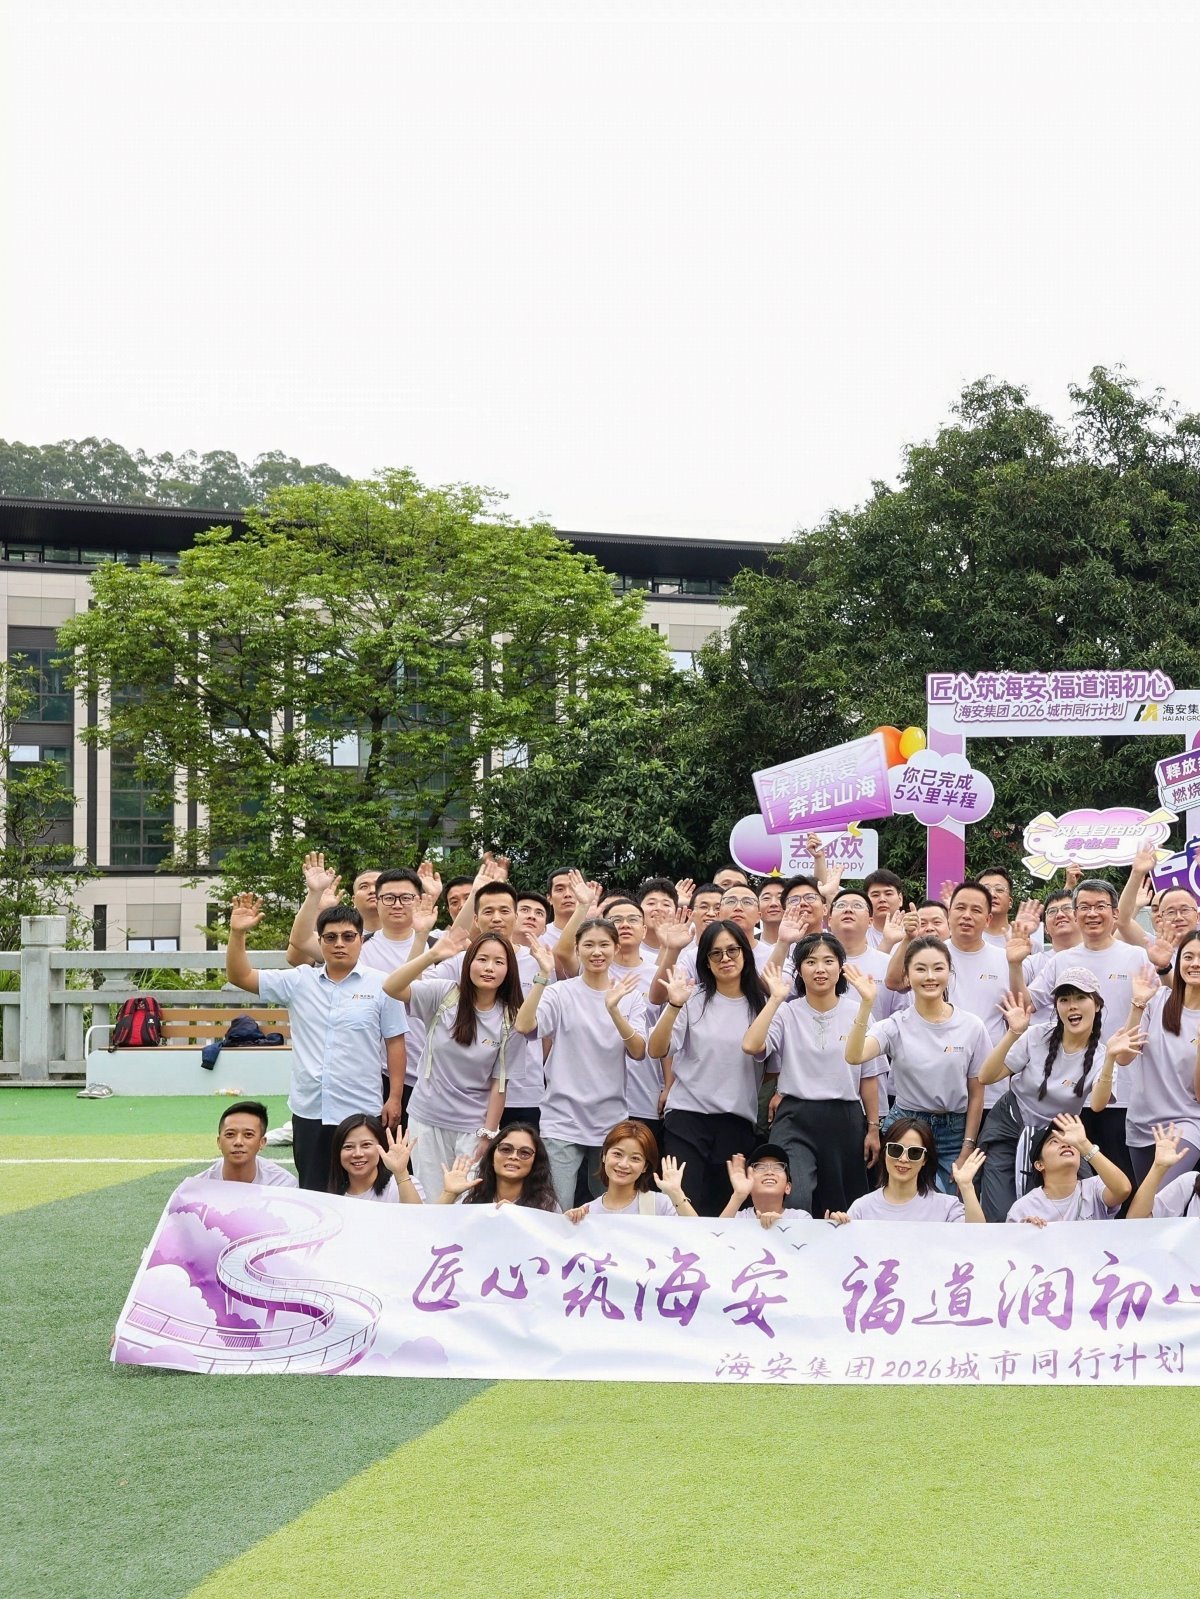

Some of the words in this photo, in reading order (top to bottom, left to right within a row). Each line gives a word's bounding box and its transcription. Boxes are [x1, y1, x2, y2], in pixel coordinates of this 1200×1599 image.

[930, 674, 1047, 701] 匠心筑海安
[1051, 673, 1171, 700] 福道润初心
[958, 704, 1010, 718] 海安集团
[1011, 704, 1044, 717] 2026
[1046, 702, 1124, 717] 城市同行计划
[903, 766, 974, 791] 你已完成
[788, 775, 877, 822] 奔赴山海
[893, 784, 978, 810] 5公里半程
[788, 859, 816, 869] Craz
[412, 1243, 789, 1339] 匠心筑海安
